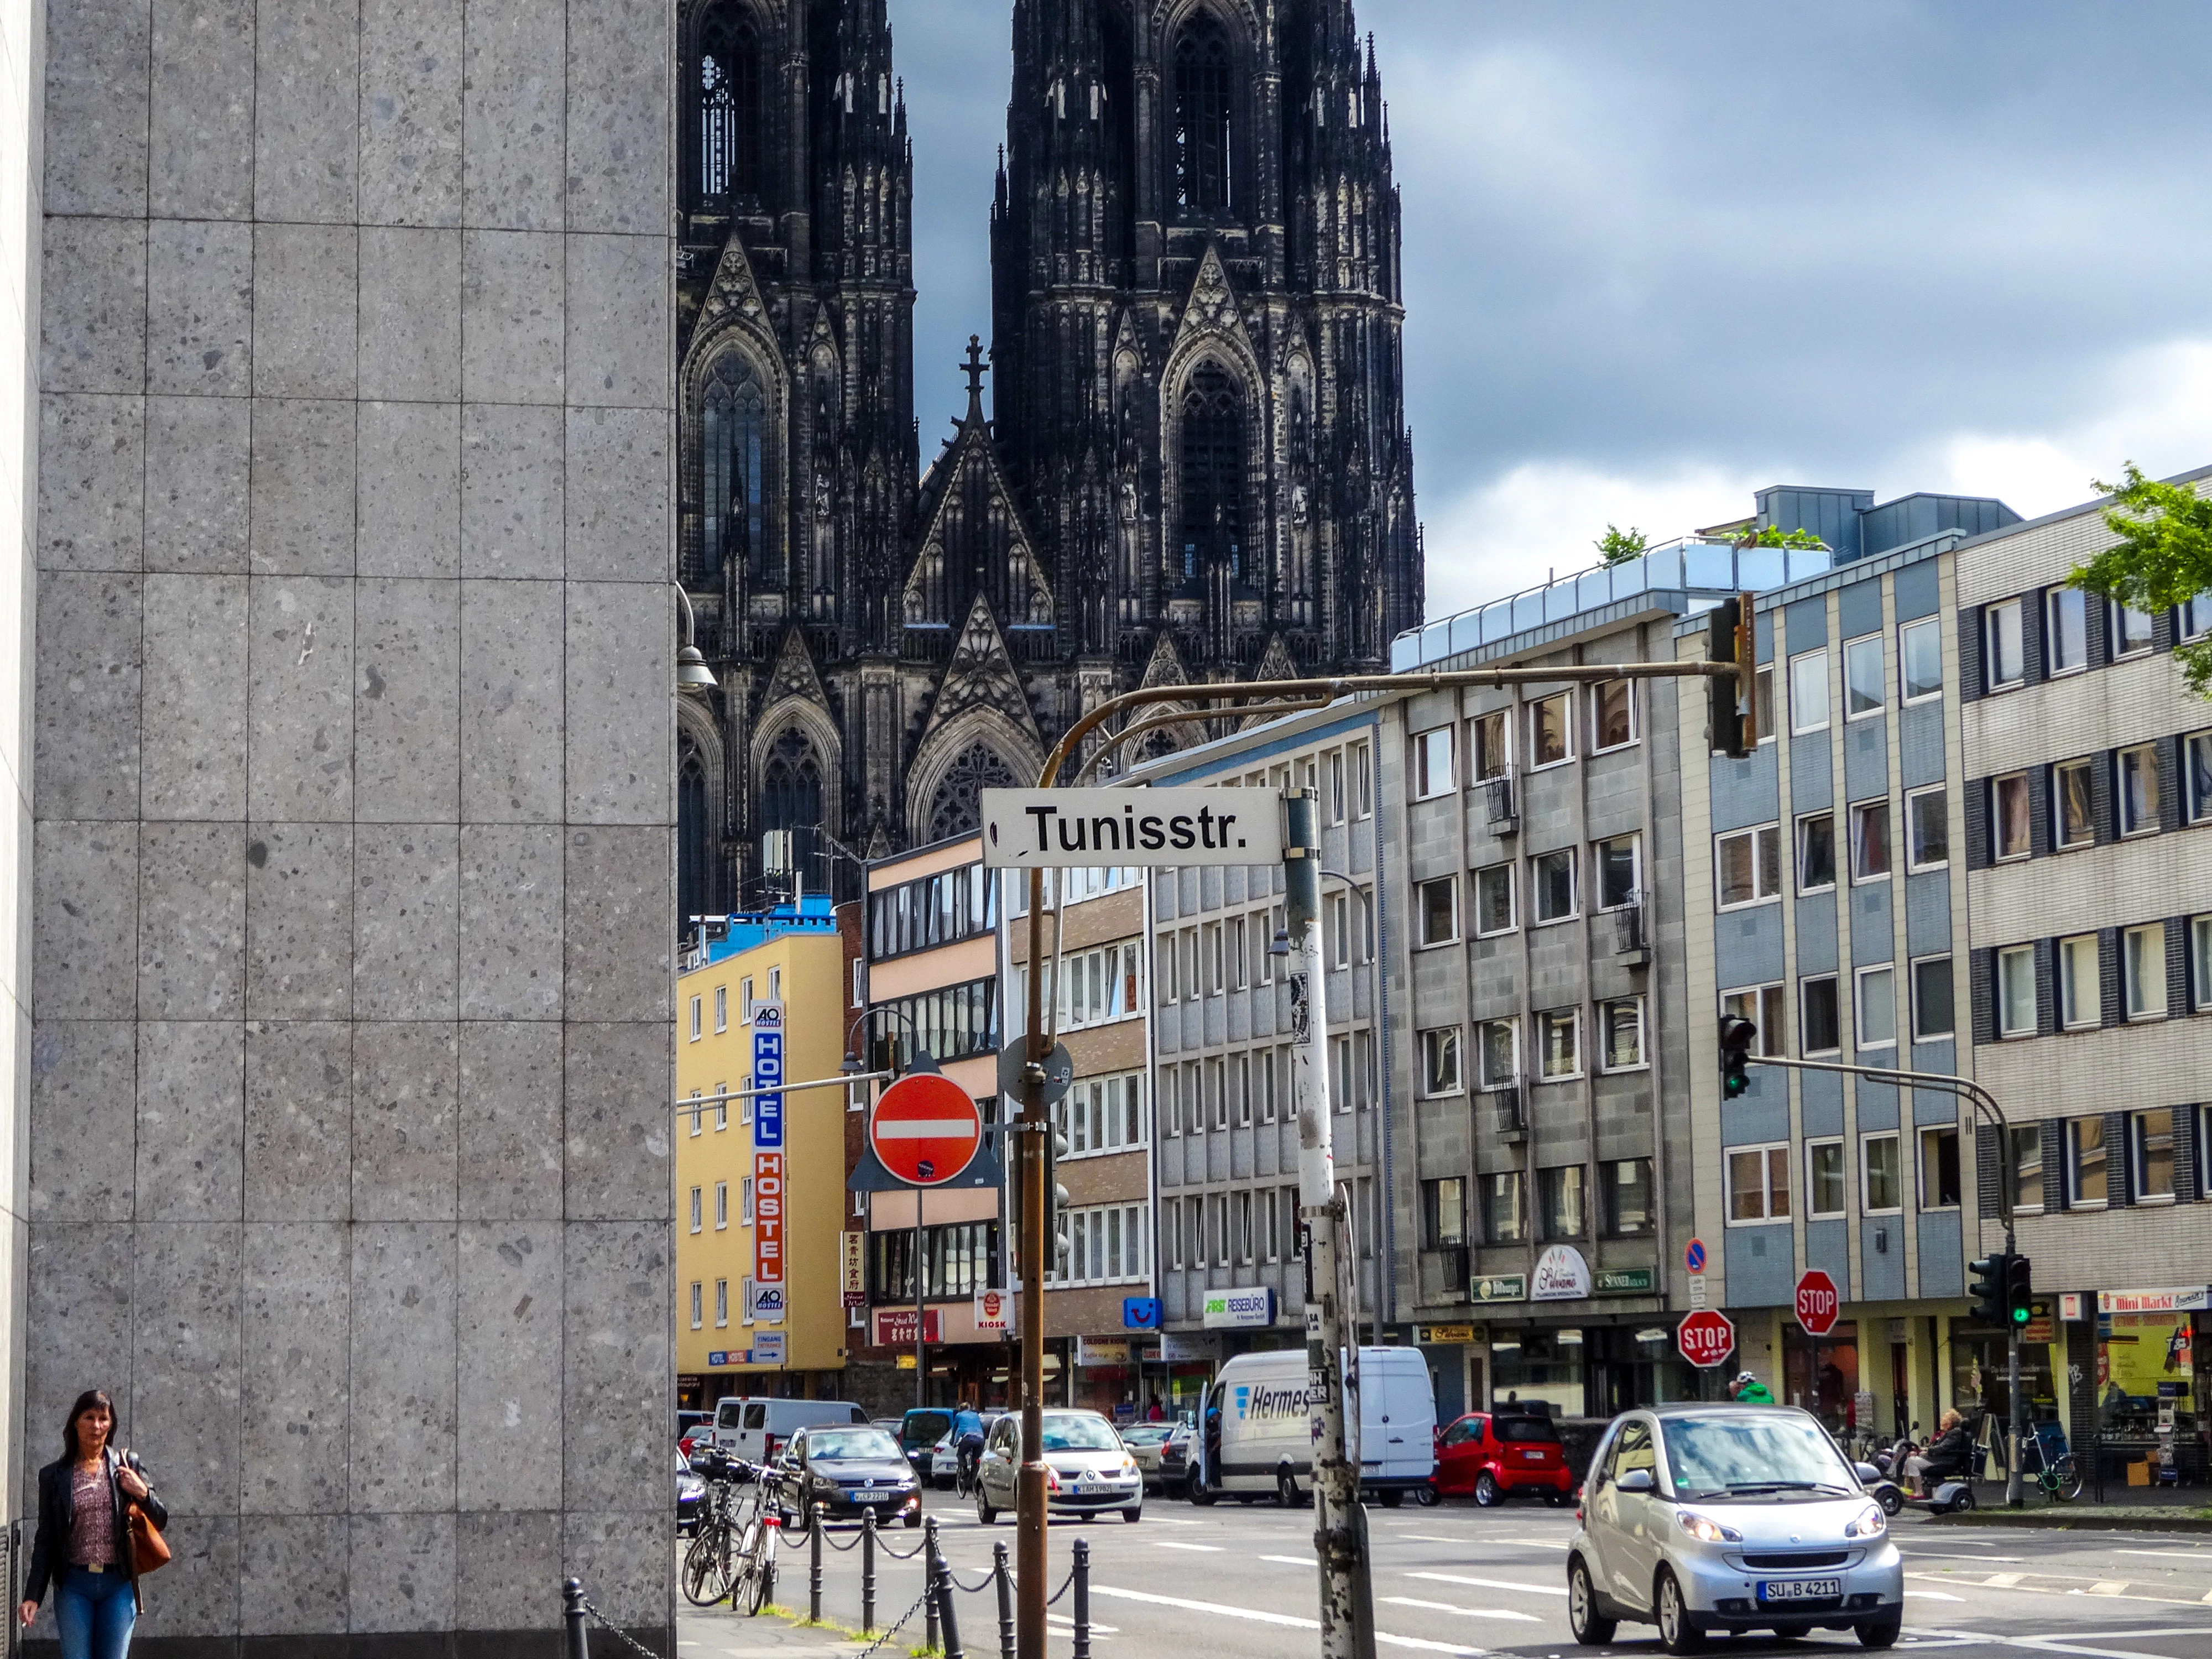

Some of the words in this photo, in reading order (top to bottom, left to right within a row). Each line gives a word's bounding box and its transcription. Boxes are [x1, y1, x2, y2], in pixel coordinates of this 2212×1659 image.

[1025, 805, 1246, 852] Tunisstr.
[757, 1037, 779, 1139] HOTEL
[758, 1156, 780, 1280] HOSTEL
[1228, 1294, 1264, 1312] REISEBÜRO
[1799, 1289, 1834, 1315] STOP
[2116, 1296, 2138, 1311] Mini
[2142, 1295, 2173, 1309] Markt
[1684, 1326, 1728, 1350] STOP
[1250, 1385, 1310, 1420] Hermes
[1768, 1583, 1785, 1597] SU
[1793, 1583, 1803, 1596] B
[1806, 1581, 1838, 1595] 4211
